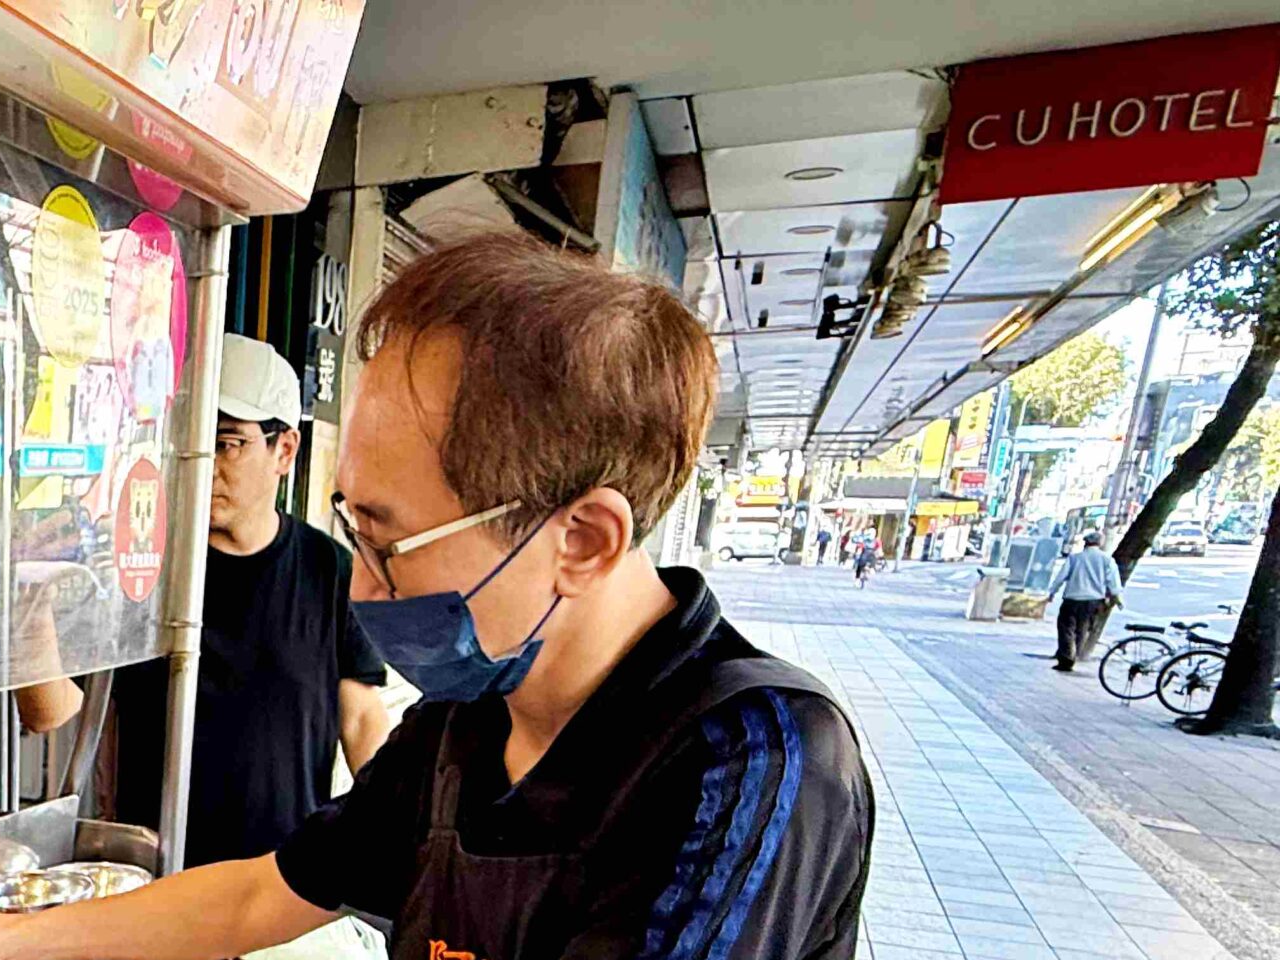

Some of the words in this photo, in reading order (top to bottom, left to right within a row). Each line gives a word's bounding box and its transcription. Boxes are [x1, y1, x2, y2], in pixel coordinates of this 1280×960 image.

[1068, 88, 1254, 142] HOTEL
[63, 283, 99, 317] 2025
[313, 253, 348, 336] 198
